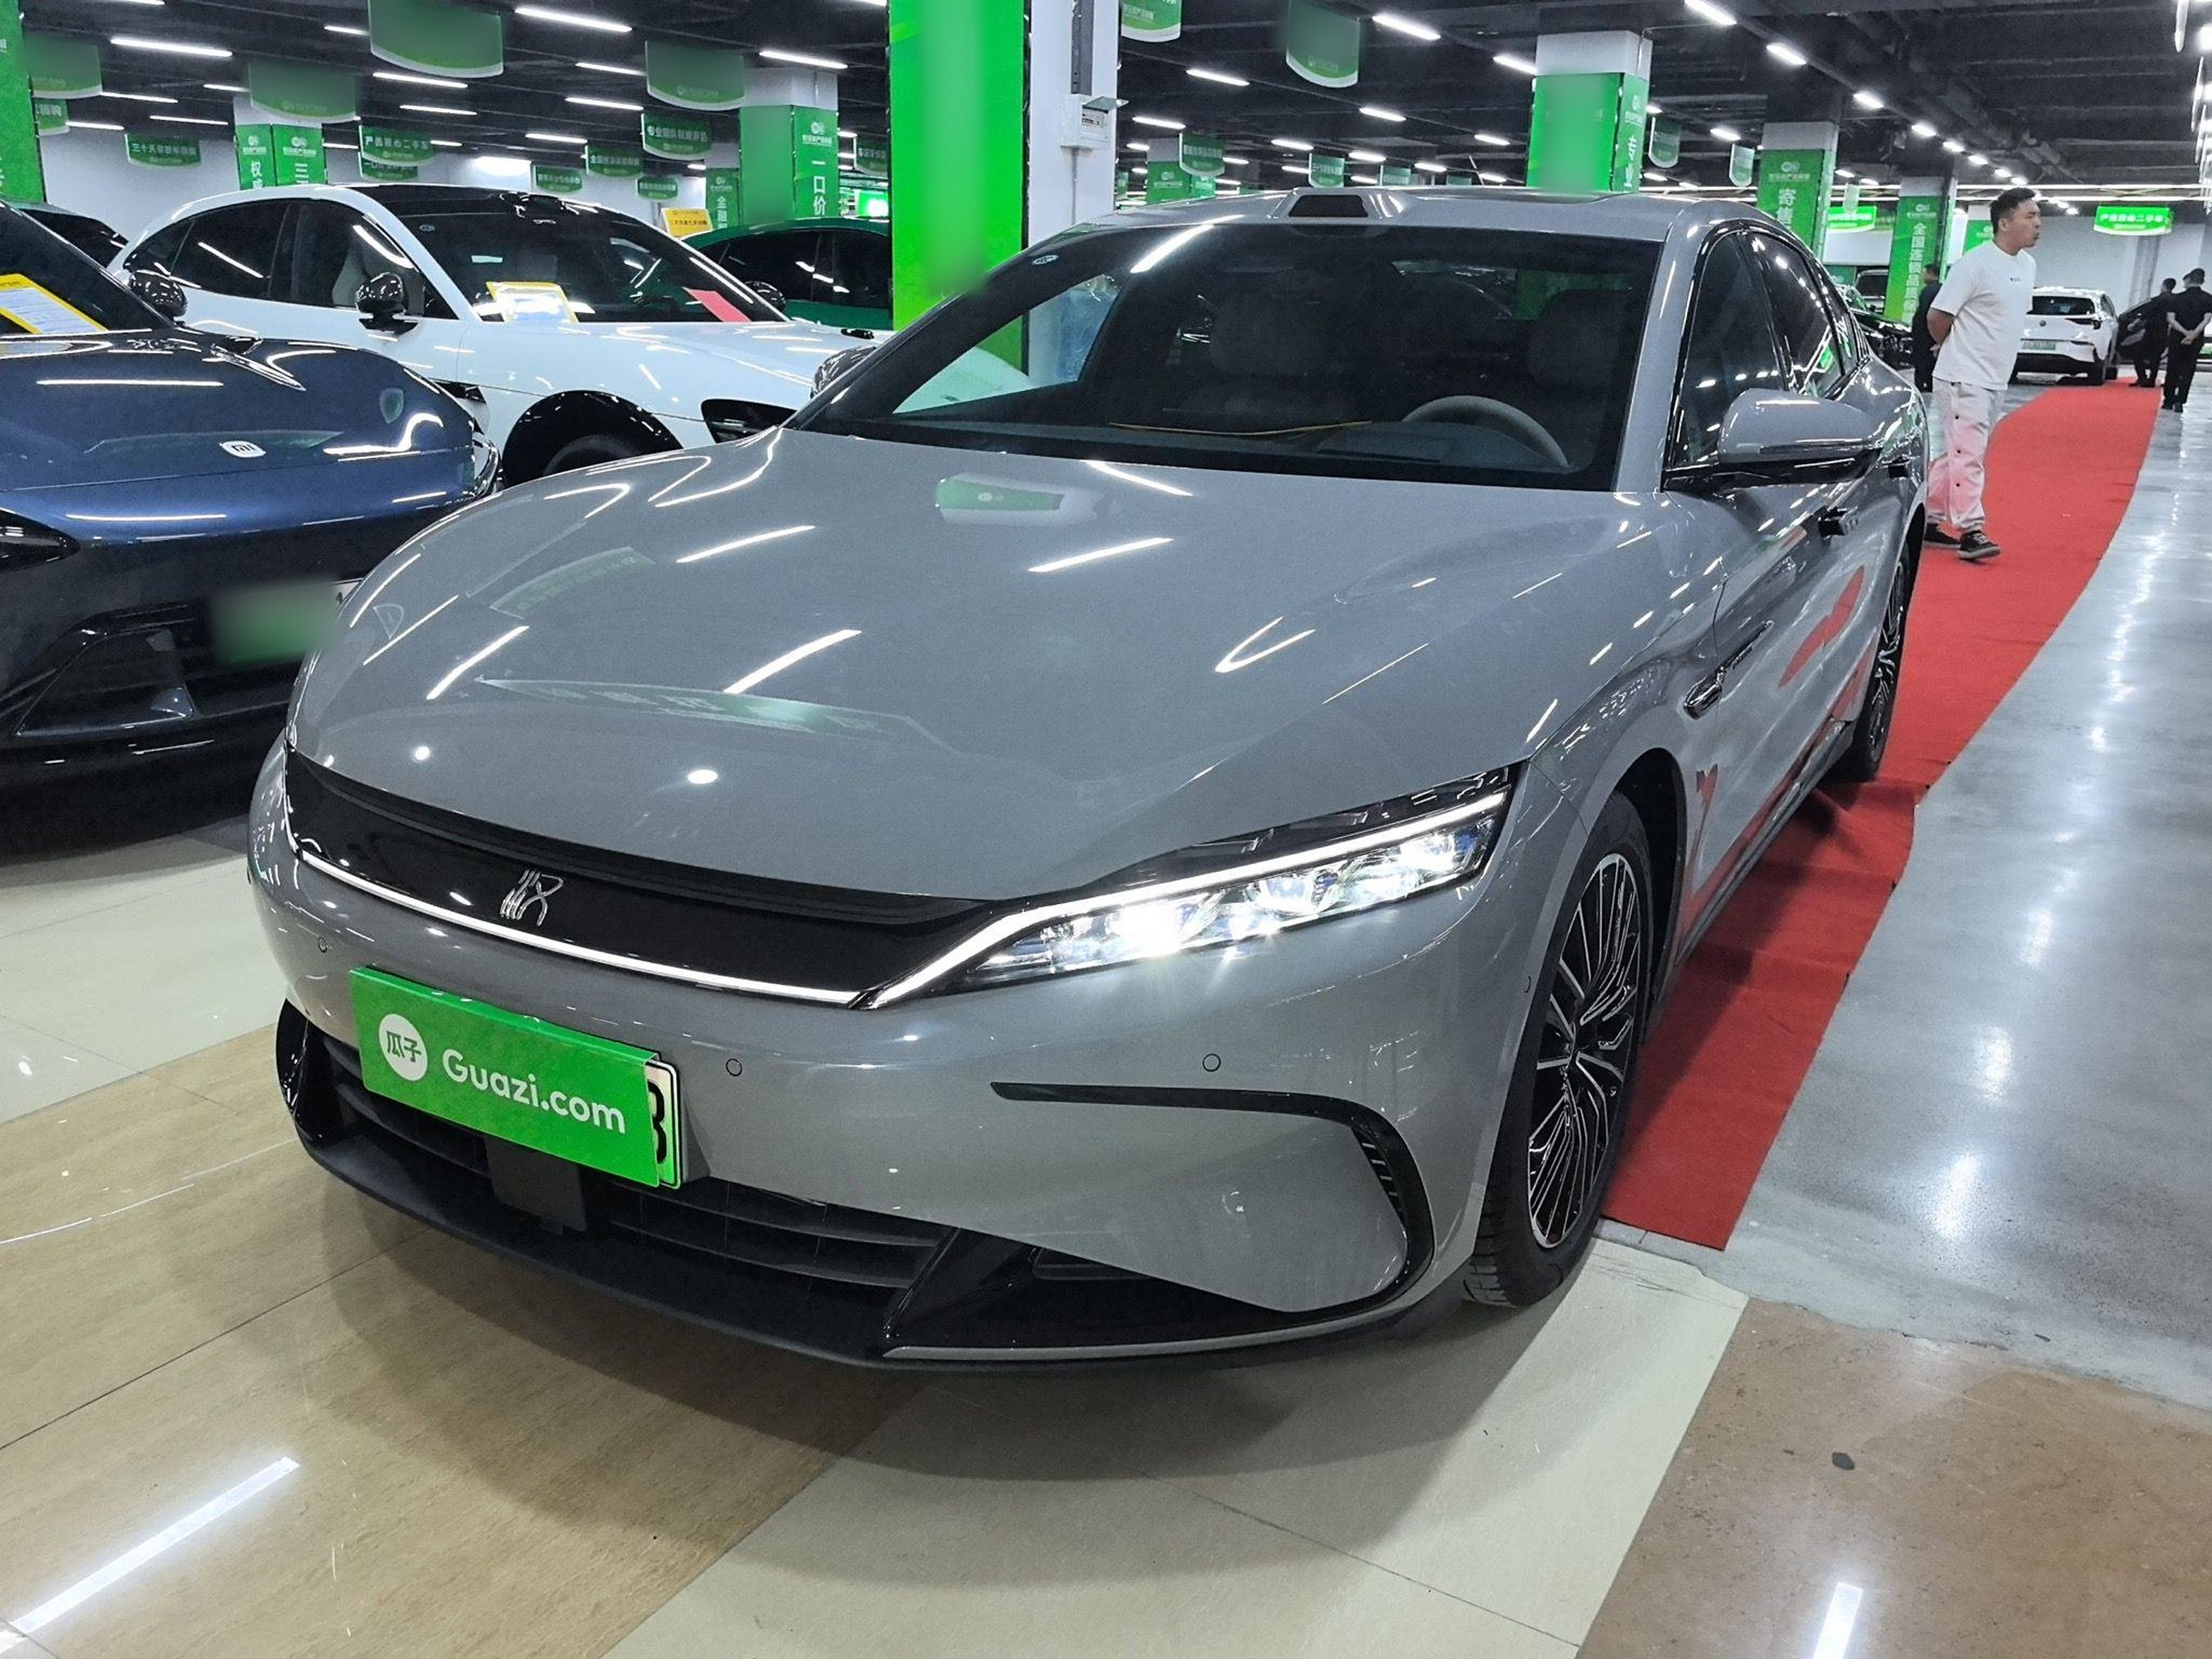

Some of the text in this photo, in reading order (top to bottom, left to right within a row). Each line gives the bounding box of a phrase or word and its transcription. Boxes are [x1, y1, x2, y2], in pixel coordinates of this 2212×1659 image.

[812, 160, 826, 215] 一口价
[386, 1030, 626, 1135] 瓜子 Guazi.com
